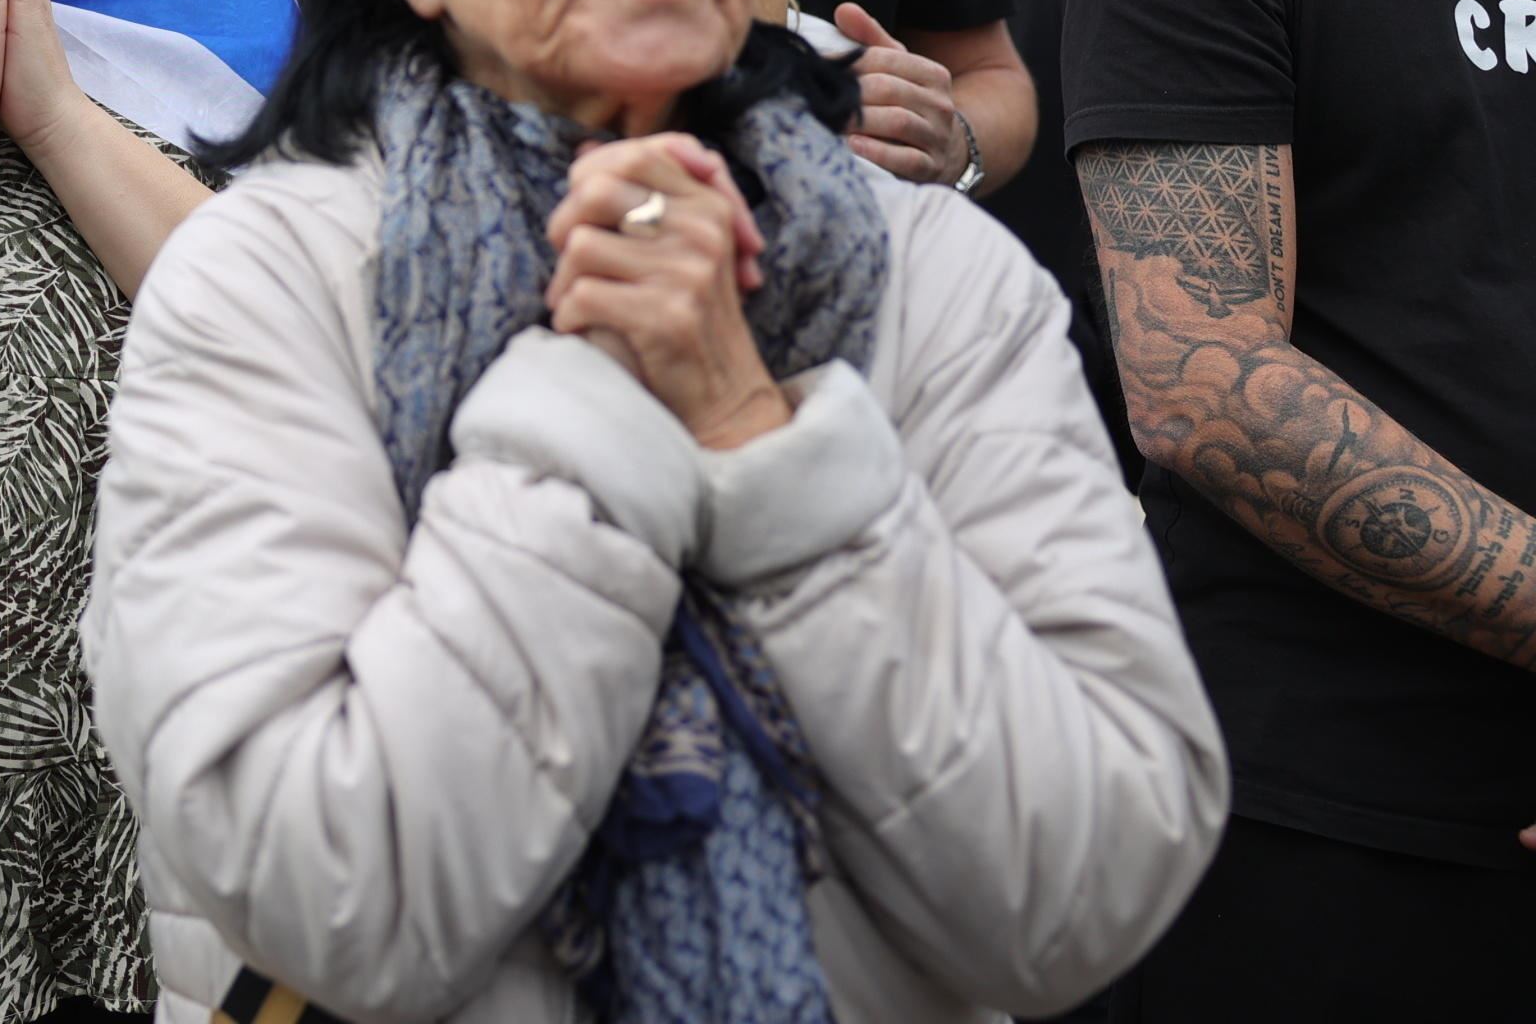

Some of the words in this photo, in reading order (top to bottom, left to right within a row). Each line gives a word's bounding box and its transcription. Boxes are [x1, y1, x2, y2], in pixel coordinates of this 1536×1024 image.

[1267, 182, 1281, 199] IT
[1270, 204, 1284, 258] DREAM
[1271, 261, 1285, 312] DON'T
